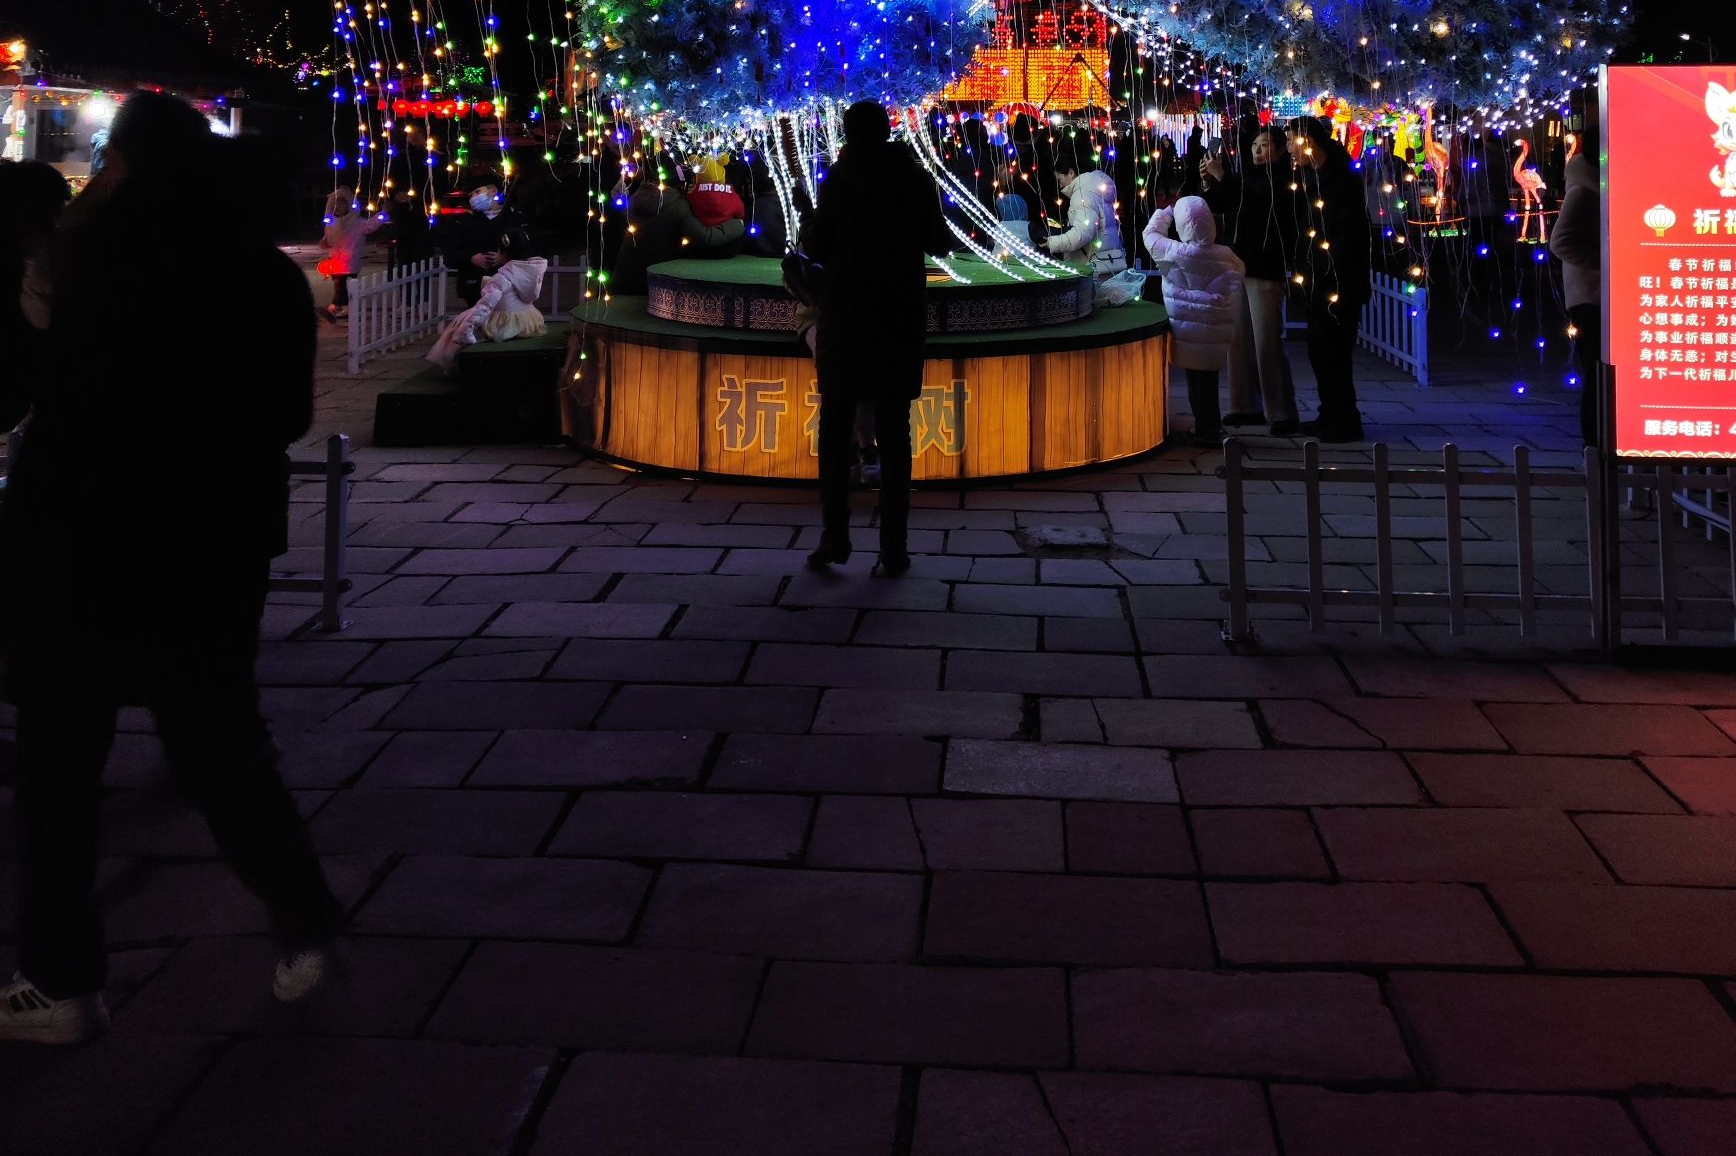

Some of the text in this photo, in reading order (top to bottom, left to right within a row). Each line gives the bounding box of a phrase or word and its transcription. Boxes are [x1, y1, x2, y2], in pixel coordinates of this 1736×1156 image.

[698, 183, 712, 192] JUST
[714, 183, 725, 193] DO
[1668, 258, 1736, 272] 春节祈福
[717, 374, 971, 458] 祈树
